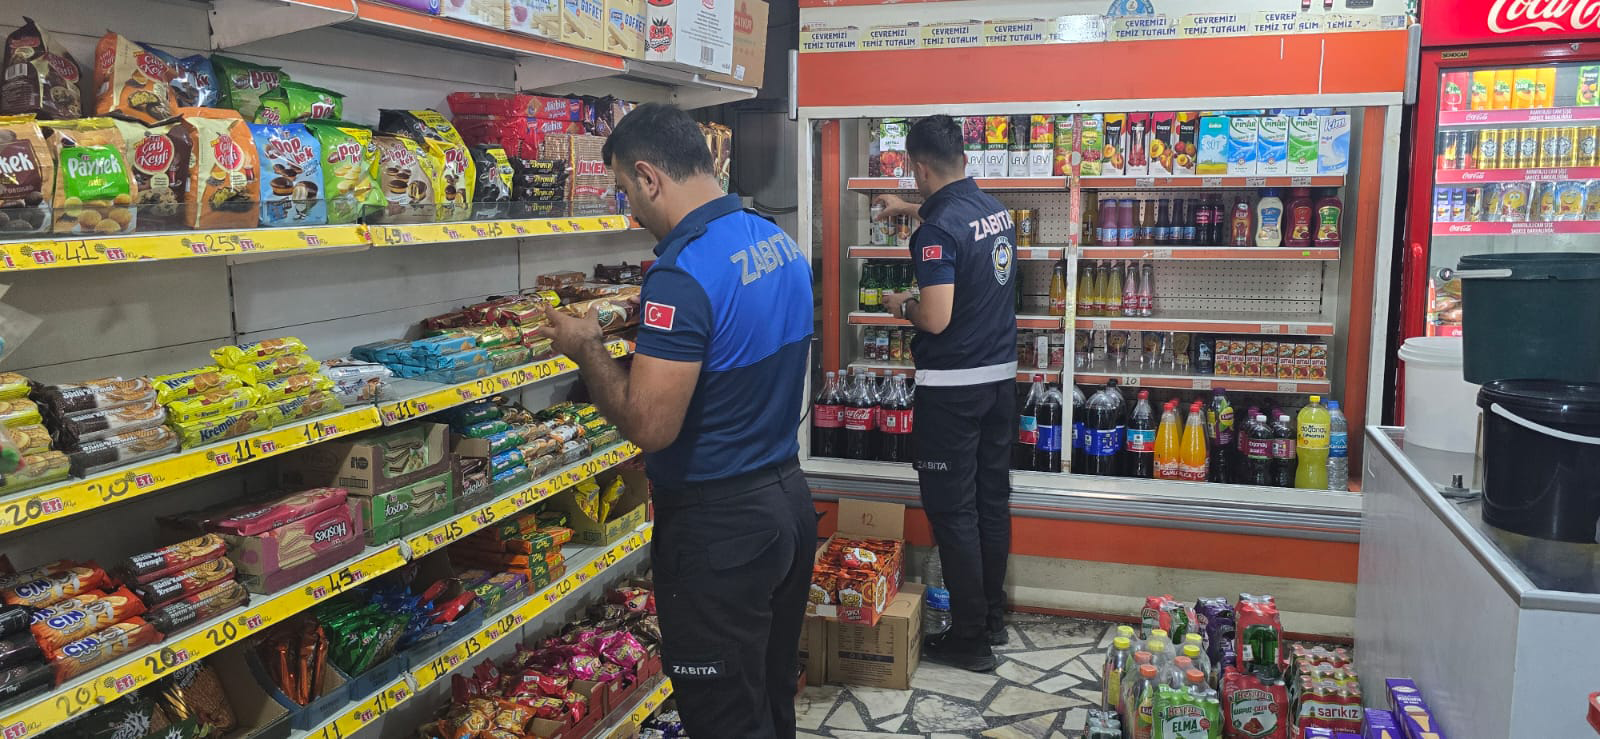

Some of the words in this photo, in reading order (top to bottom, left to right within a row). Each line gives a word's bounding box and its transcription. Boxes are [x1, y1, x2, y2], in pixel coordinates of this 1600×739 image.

[581, 1, 602, 20] GOFRET
[625, 13, 646, 31] GOFRET
[1125, 18, 1167, 28] ÇEVREMİZİ
[1194, 15, 1237, 25] ÇEVREMİZİ
[1254, 23, 1280, 32] TEMİZ
[1283, 21, 1319, 31] TUALIM
[870, 30, 907, 38] ÇEVREMİZİ
[932, 27, 969, 36] ÇEVREMİZİ
[994, 24, 1033, 33] ÇEVREMİZİ
[1116, 29, 1139, 37] TEMİZ
[1142, 27, 1176, 36] TUTALIM
[1184, 27, 1208, 35] TEMİZ
[1211, 25, 1246, 33] TUTALIM
[812, 32, 847, 40] ÇEVREMİZİ
[885, 38, 915, 46] TUTALIM
[923, 38, 943, 46] TEMİZ
[946, 36, 978, 44] TUTALIM
[985, 35, 1006, 43] TEMİZ
[1009, 33, 1042, 42] TUTALIM
[826, 40, 855, 48] TUTALIM
[338, 144, 360, 161] Pop
[968, 210, 1015, 242] ZABITA
[205, 235, 236, 251] 25
[240, 240, 255, 249] ETi
[307, 236, 320, 245] ETi
[106, 249, 127, 260] ETi
[192, 243, 208, 253] ETi
[33, 250, 56, 263] ETi
[729, 232, 801, 286] ZABITA
[536, 363, 551, 378] 20
[1126, 377, 1137, 385] 10
[396, 402, 416, 420] 11
[304, 422, 324, 443] 11
[324, 426, 337, 436] ETi
[235, 440, 256, 463] 11
[262, 442, 276, 453] ETi
[215, 453, 231, 466] ETi
[917, 461, 948, 471] ZABITA
[582, 462, 597, 475] 30
[136, 474, 154, 488] ETi
[550, 476, 569, 490] 22
[6, 499, 42, 526] 20
[42, 499, 63, 514] ETi
[862, 512, 874, 527] 12
[446, 522, 463, 542] 45
[328, 568, 352, 593] 45
[556, 579, 571, 595] 20
[312, 587, 326, 599] ETi
[49, 610, 85, 629] CIN
[247, 616, 261, 628] ETi
[497, 614, 514, 633] 20
[206, 621, 237, 646] 20
[63, 637, 99, 657] CIN
[464, 638, 481, 657] 13
[145, 648, 176, 675] 20
[432, 658, 448, 680] 11
[673, 666, 717, 675] ZABITA
[115, 675, 134, 692] ETi
[56, 688, 90, 717] 20
[374, 691, 389, 715] 11
[361, 710, 374, 722] ETi
[1318, 706, 1358, 719] sarıkız
[3, 722, 27, 739] ETi
[1172, 720, 1197, 732] ELMA
